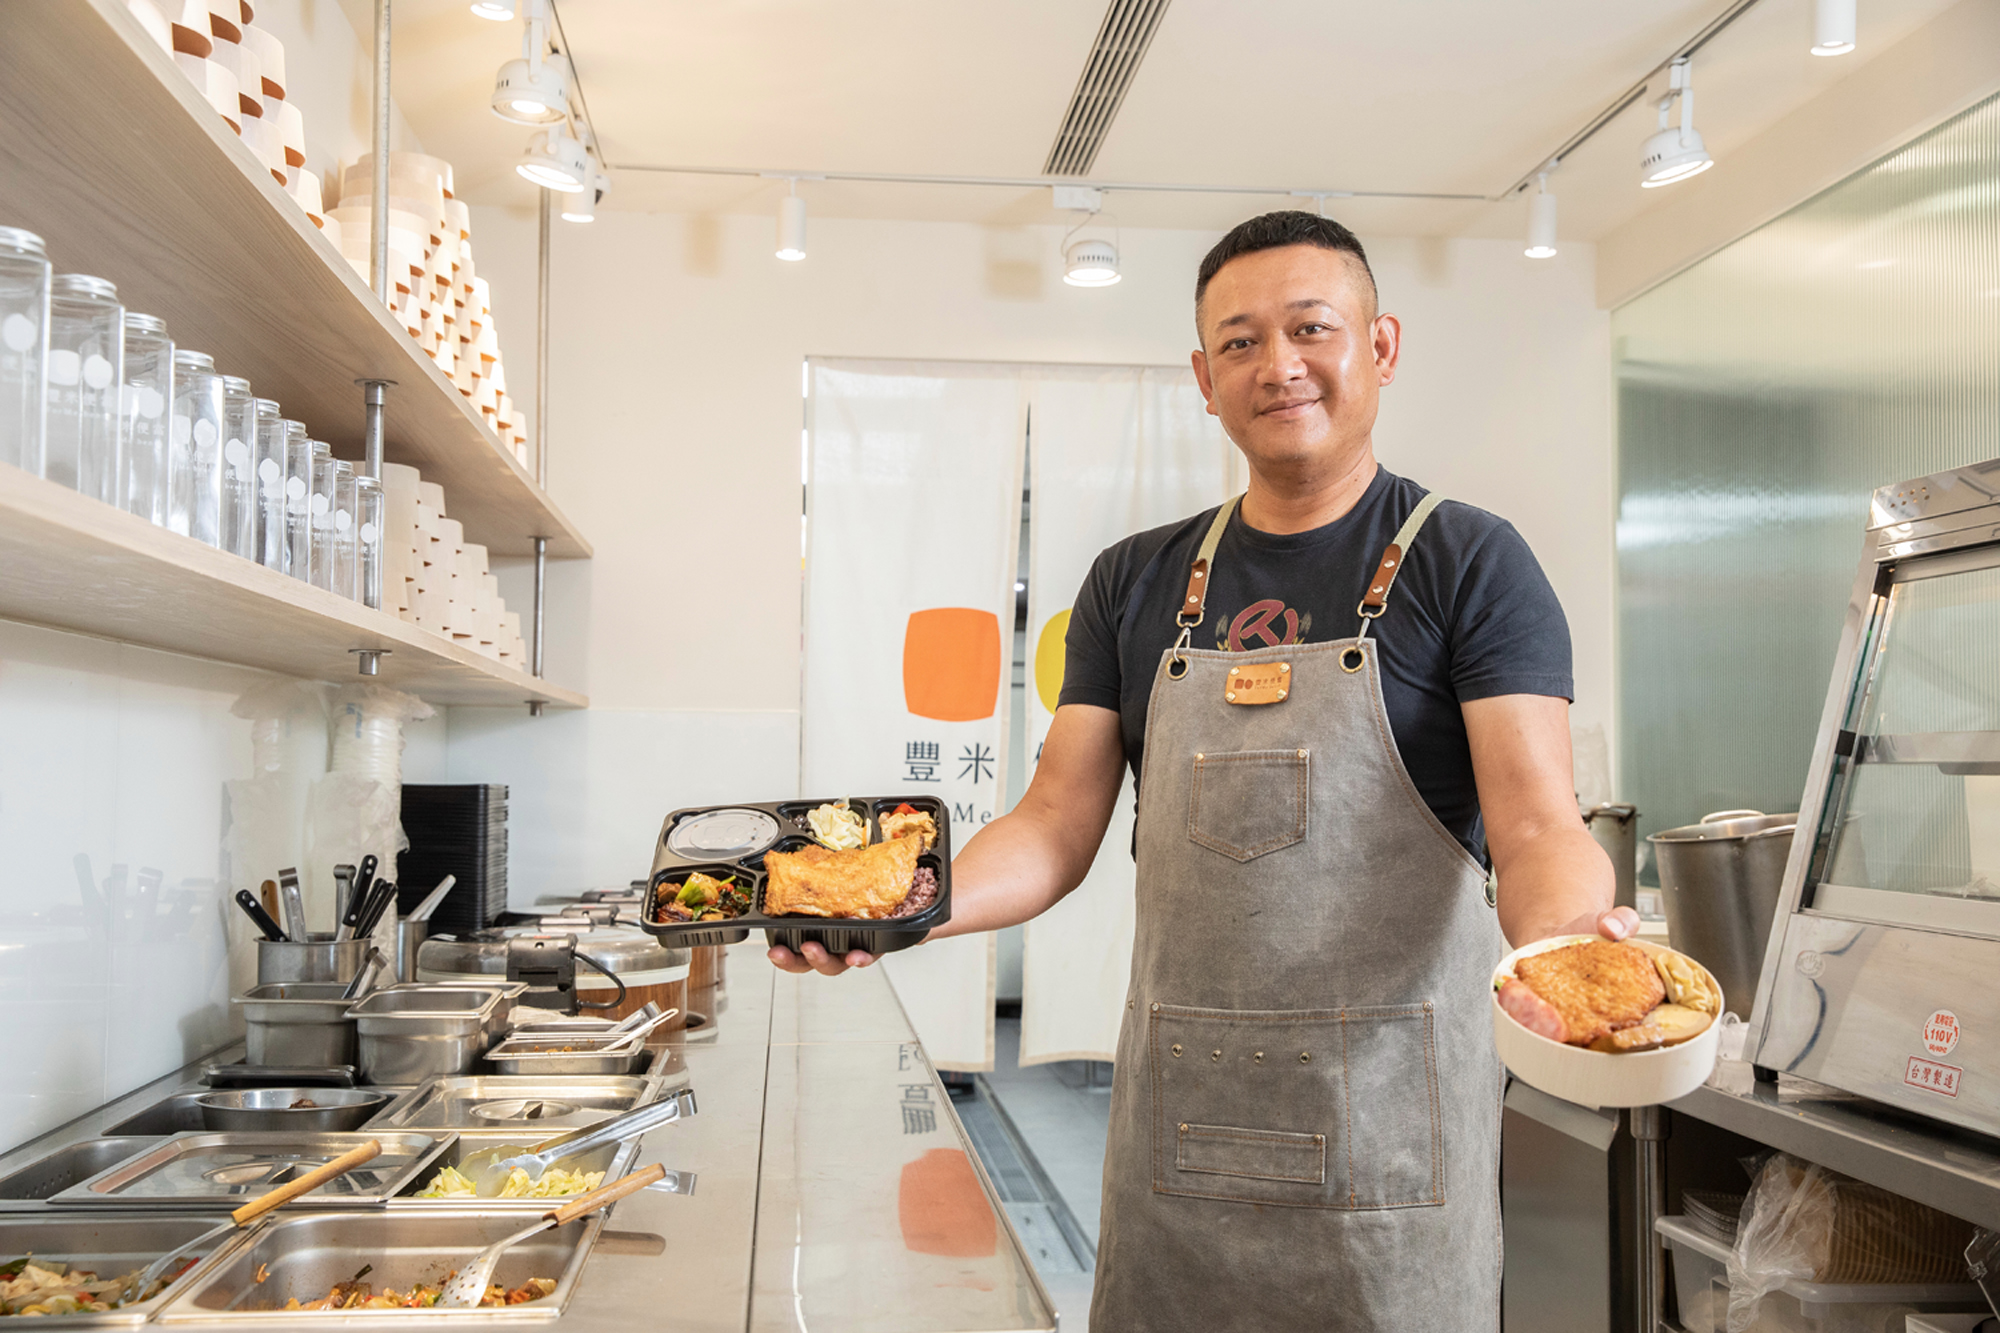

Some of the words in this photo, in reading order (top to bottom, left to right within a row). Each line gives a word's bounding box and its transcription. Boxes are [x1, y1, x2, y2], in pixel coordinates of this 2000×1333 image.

[902, 741, 995, 784] 豐米
[1930, 1028, 1953, 1044] 110V
[1911, 1064, 1954, 1089] 台灣製造
